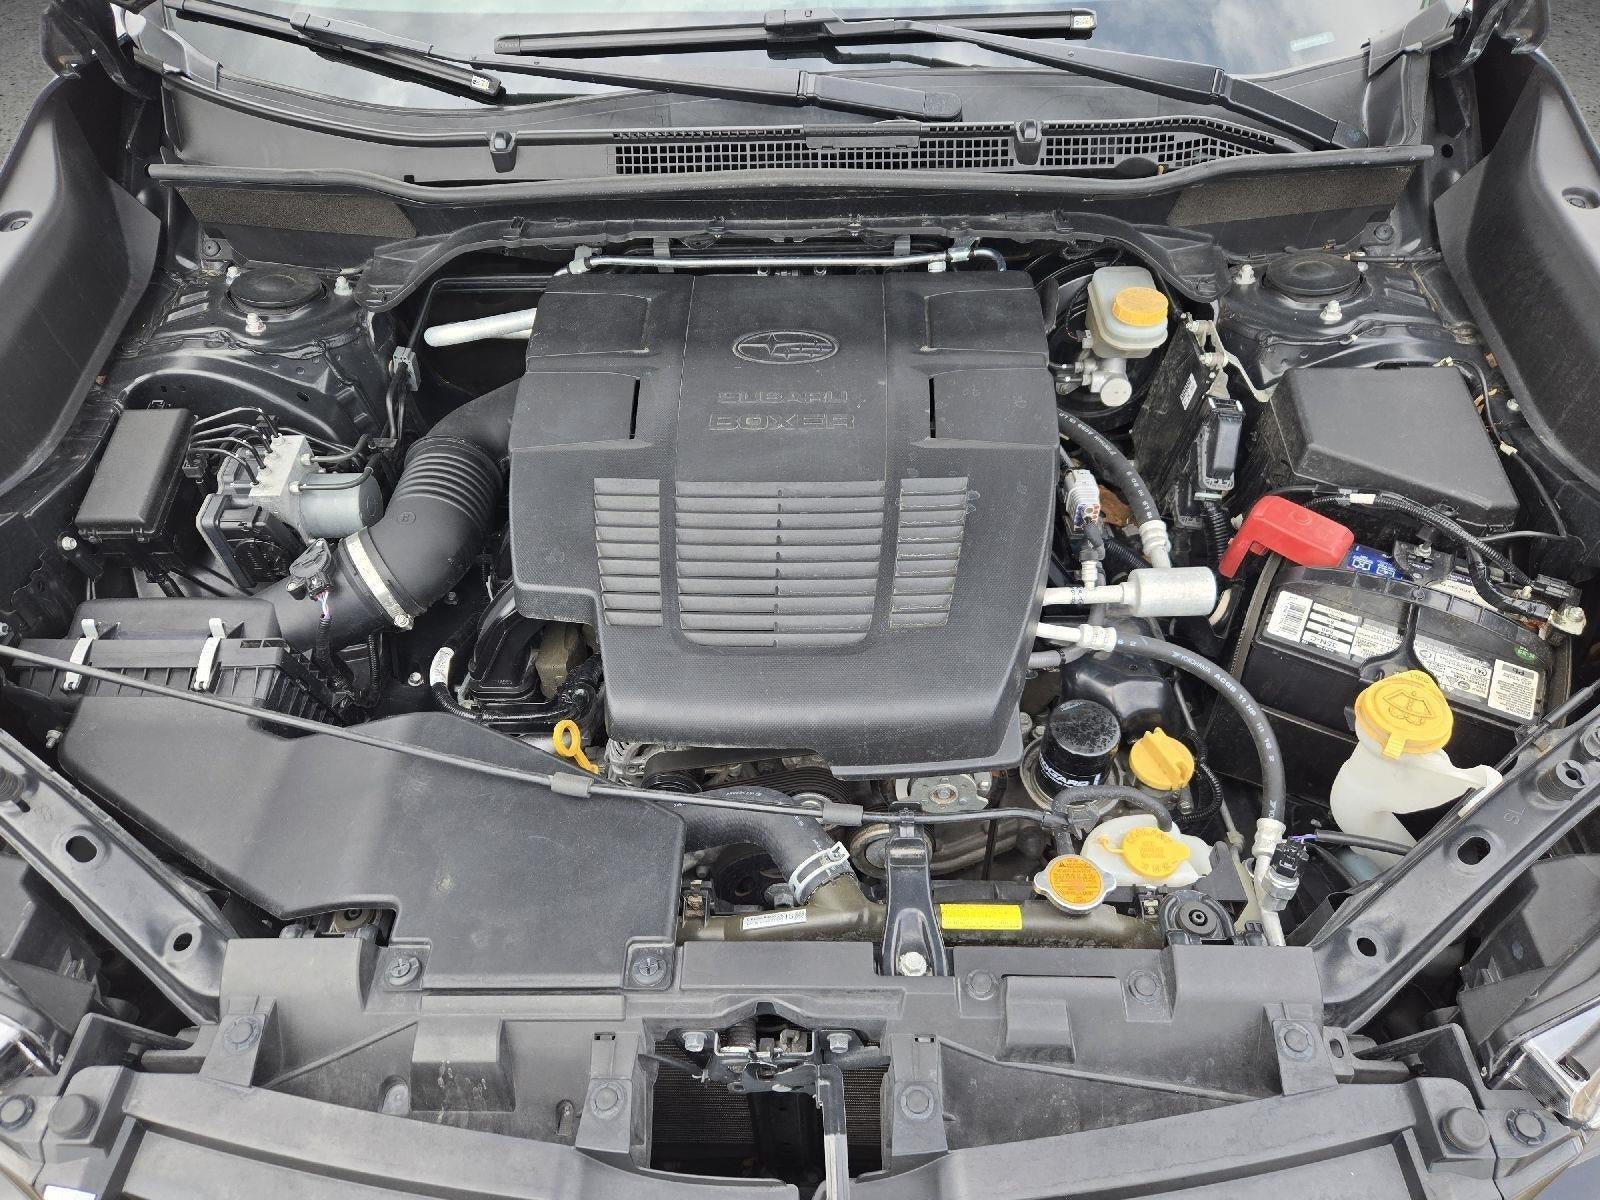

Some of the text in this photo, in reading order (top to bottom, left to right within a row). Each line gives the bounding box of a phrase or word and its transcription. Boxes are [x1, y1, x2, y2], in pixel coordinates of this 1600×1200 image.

[717, 391, 848, 403] SUBARU
[709, 413, 855, 431] BOXER
[1180, 654, 1212, 675] YOKOHAMA
